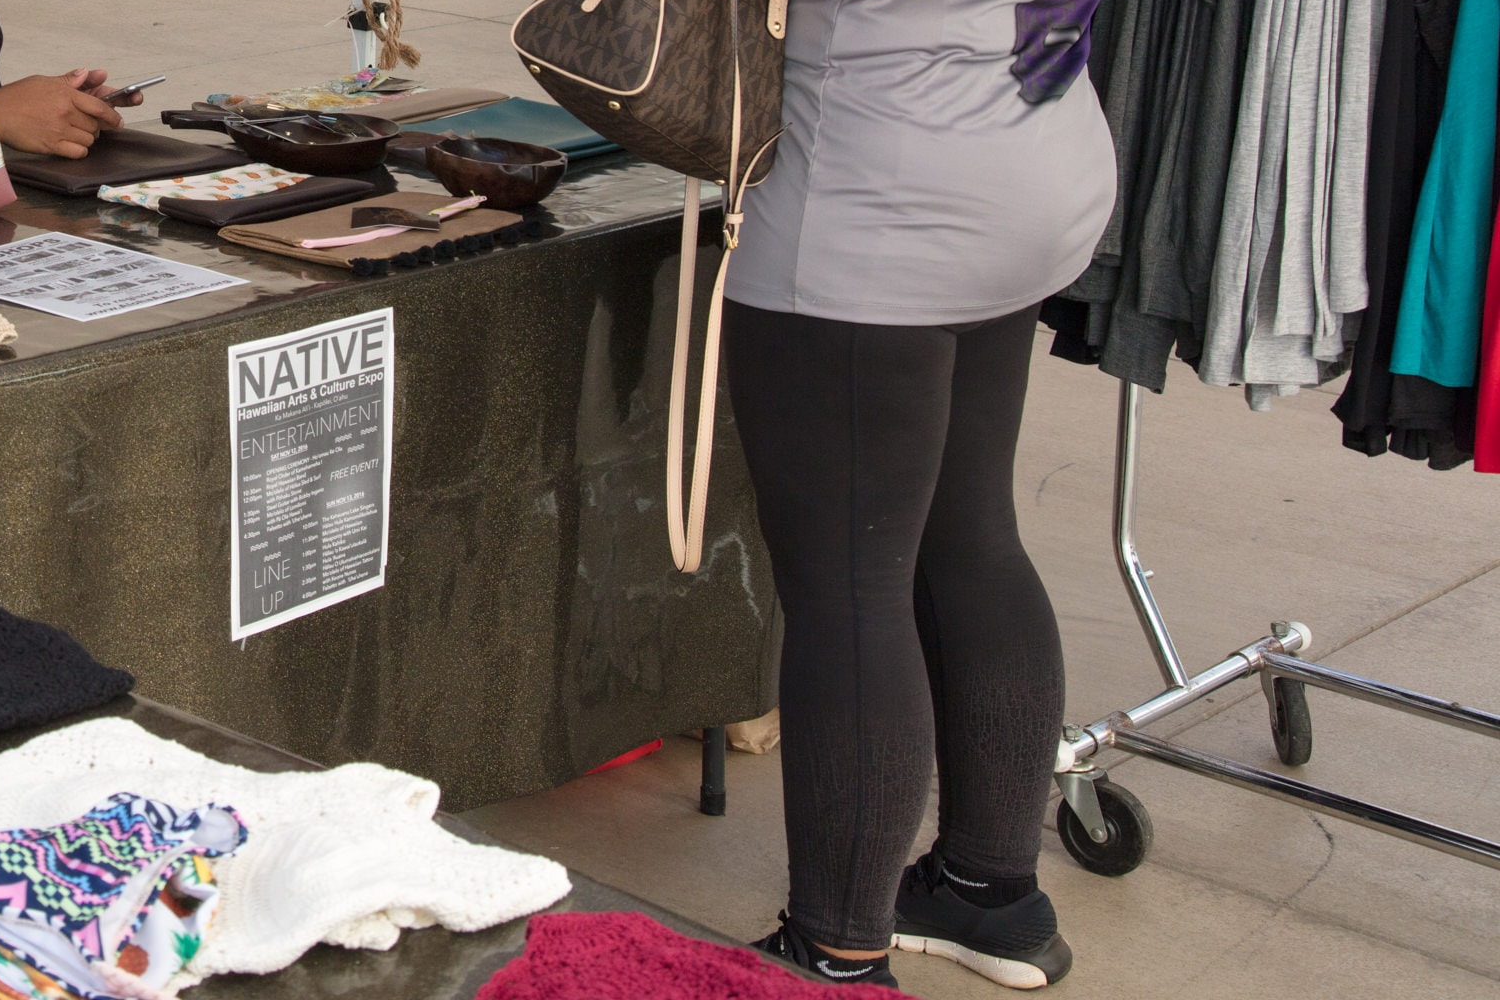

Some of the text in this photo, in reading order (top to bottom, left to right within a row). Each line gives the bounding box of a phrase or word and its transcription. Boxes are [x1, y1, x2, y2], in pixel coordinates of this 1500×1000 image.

[238, 324, 383, 404] NATIVE
[238, 371, 384, 421] Hawaiian Arts & Culture Expo
[283, 409, 301, 419] Makana
[240, 399, 381, 460] ENTERTAINMENT
[266, 465, 287, 475] OPENING
[287, 458, 309, 469] CEREMONY
[330, 458, 378, 481] FREE EVENT!
[254, 557, 290, 589] LINE
[261, 588, 283, 616] UP
